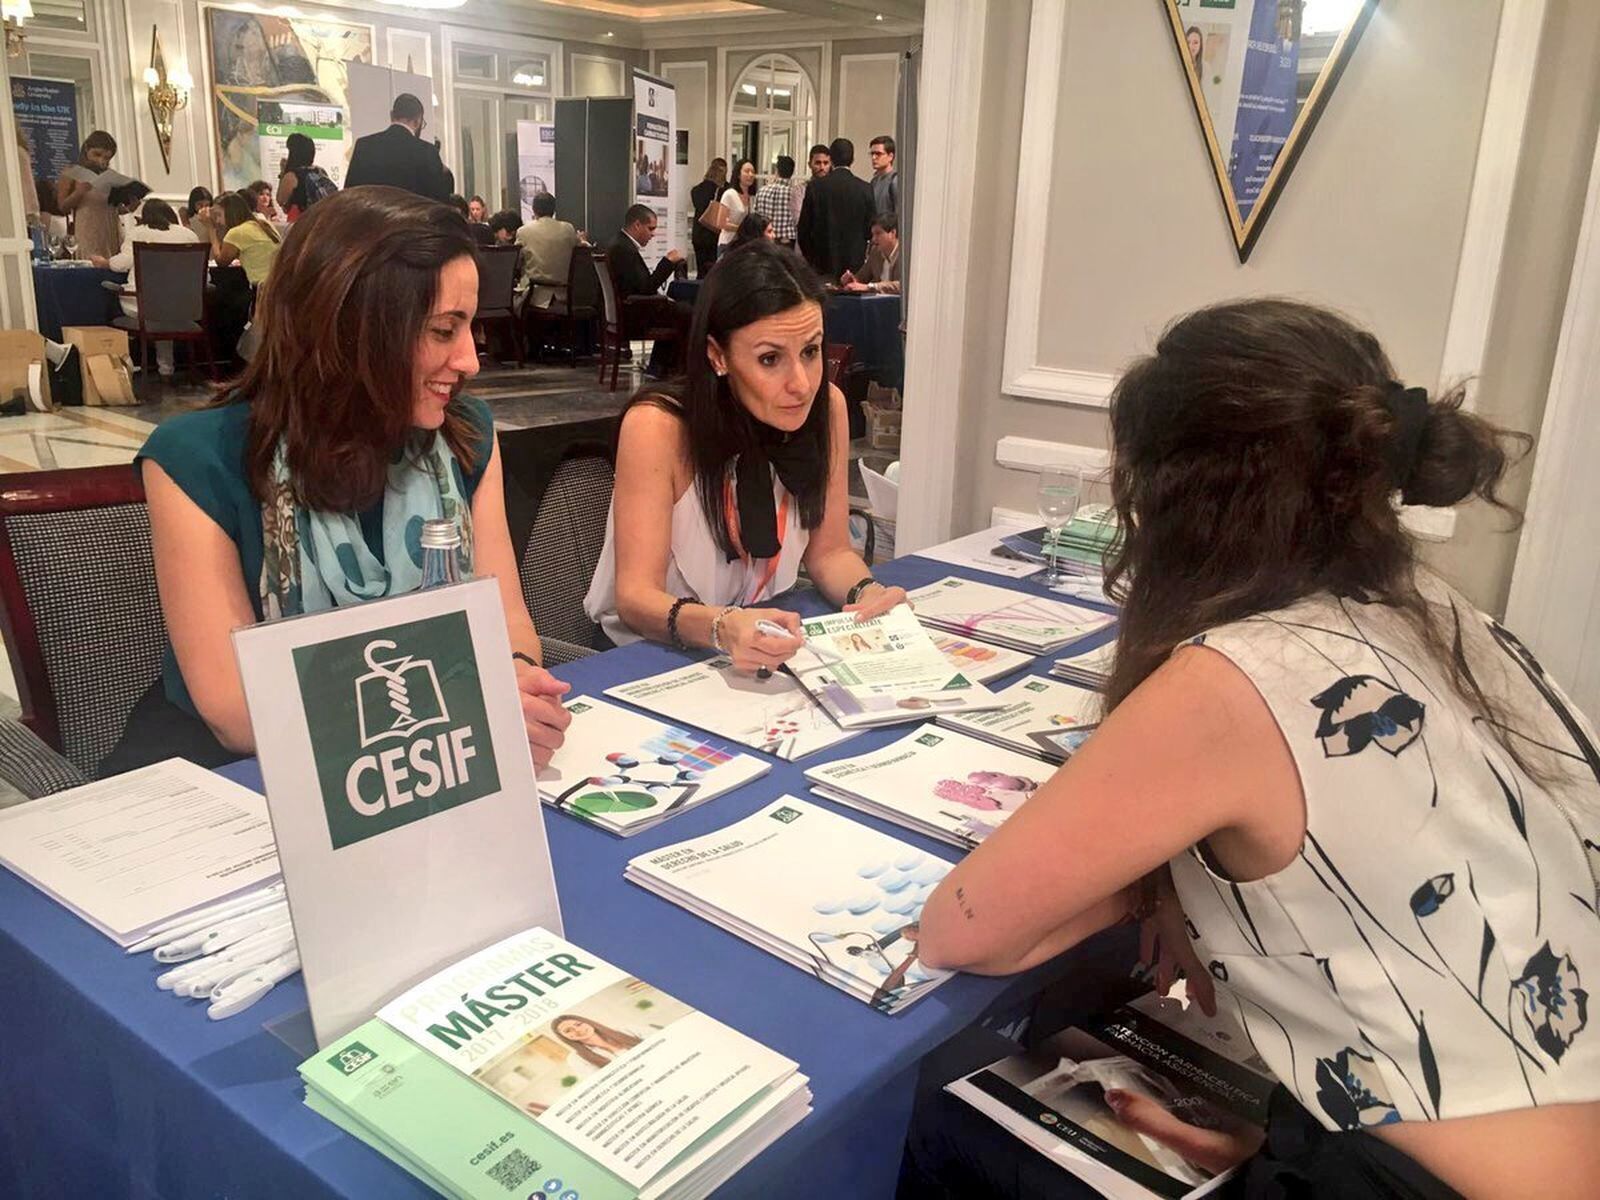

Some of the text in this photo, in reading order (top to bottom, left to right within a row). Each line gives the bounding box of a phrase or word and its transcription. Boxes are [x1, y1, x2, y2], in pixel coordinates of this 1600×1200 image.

[57, 106, 71, 114] UK
[345, 725, 477, 817] CESIF
[660, 855, 699, 870] DERECHO
[718, 840, 744, 853] SALUD
[401, 936, 556, 1025] PROGRAMAS
[426, 953, 596, 1051] MÁSTER
[460, 1029, 505, 1062] 2017
[514, 996, 559, 1027] 2018
[469, 1131, 515, 1166] cesif.es
